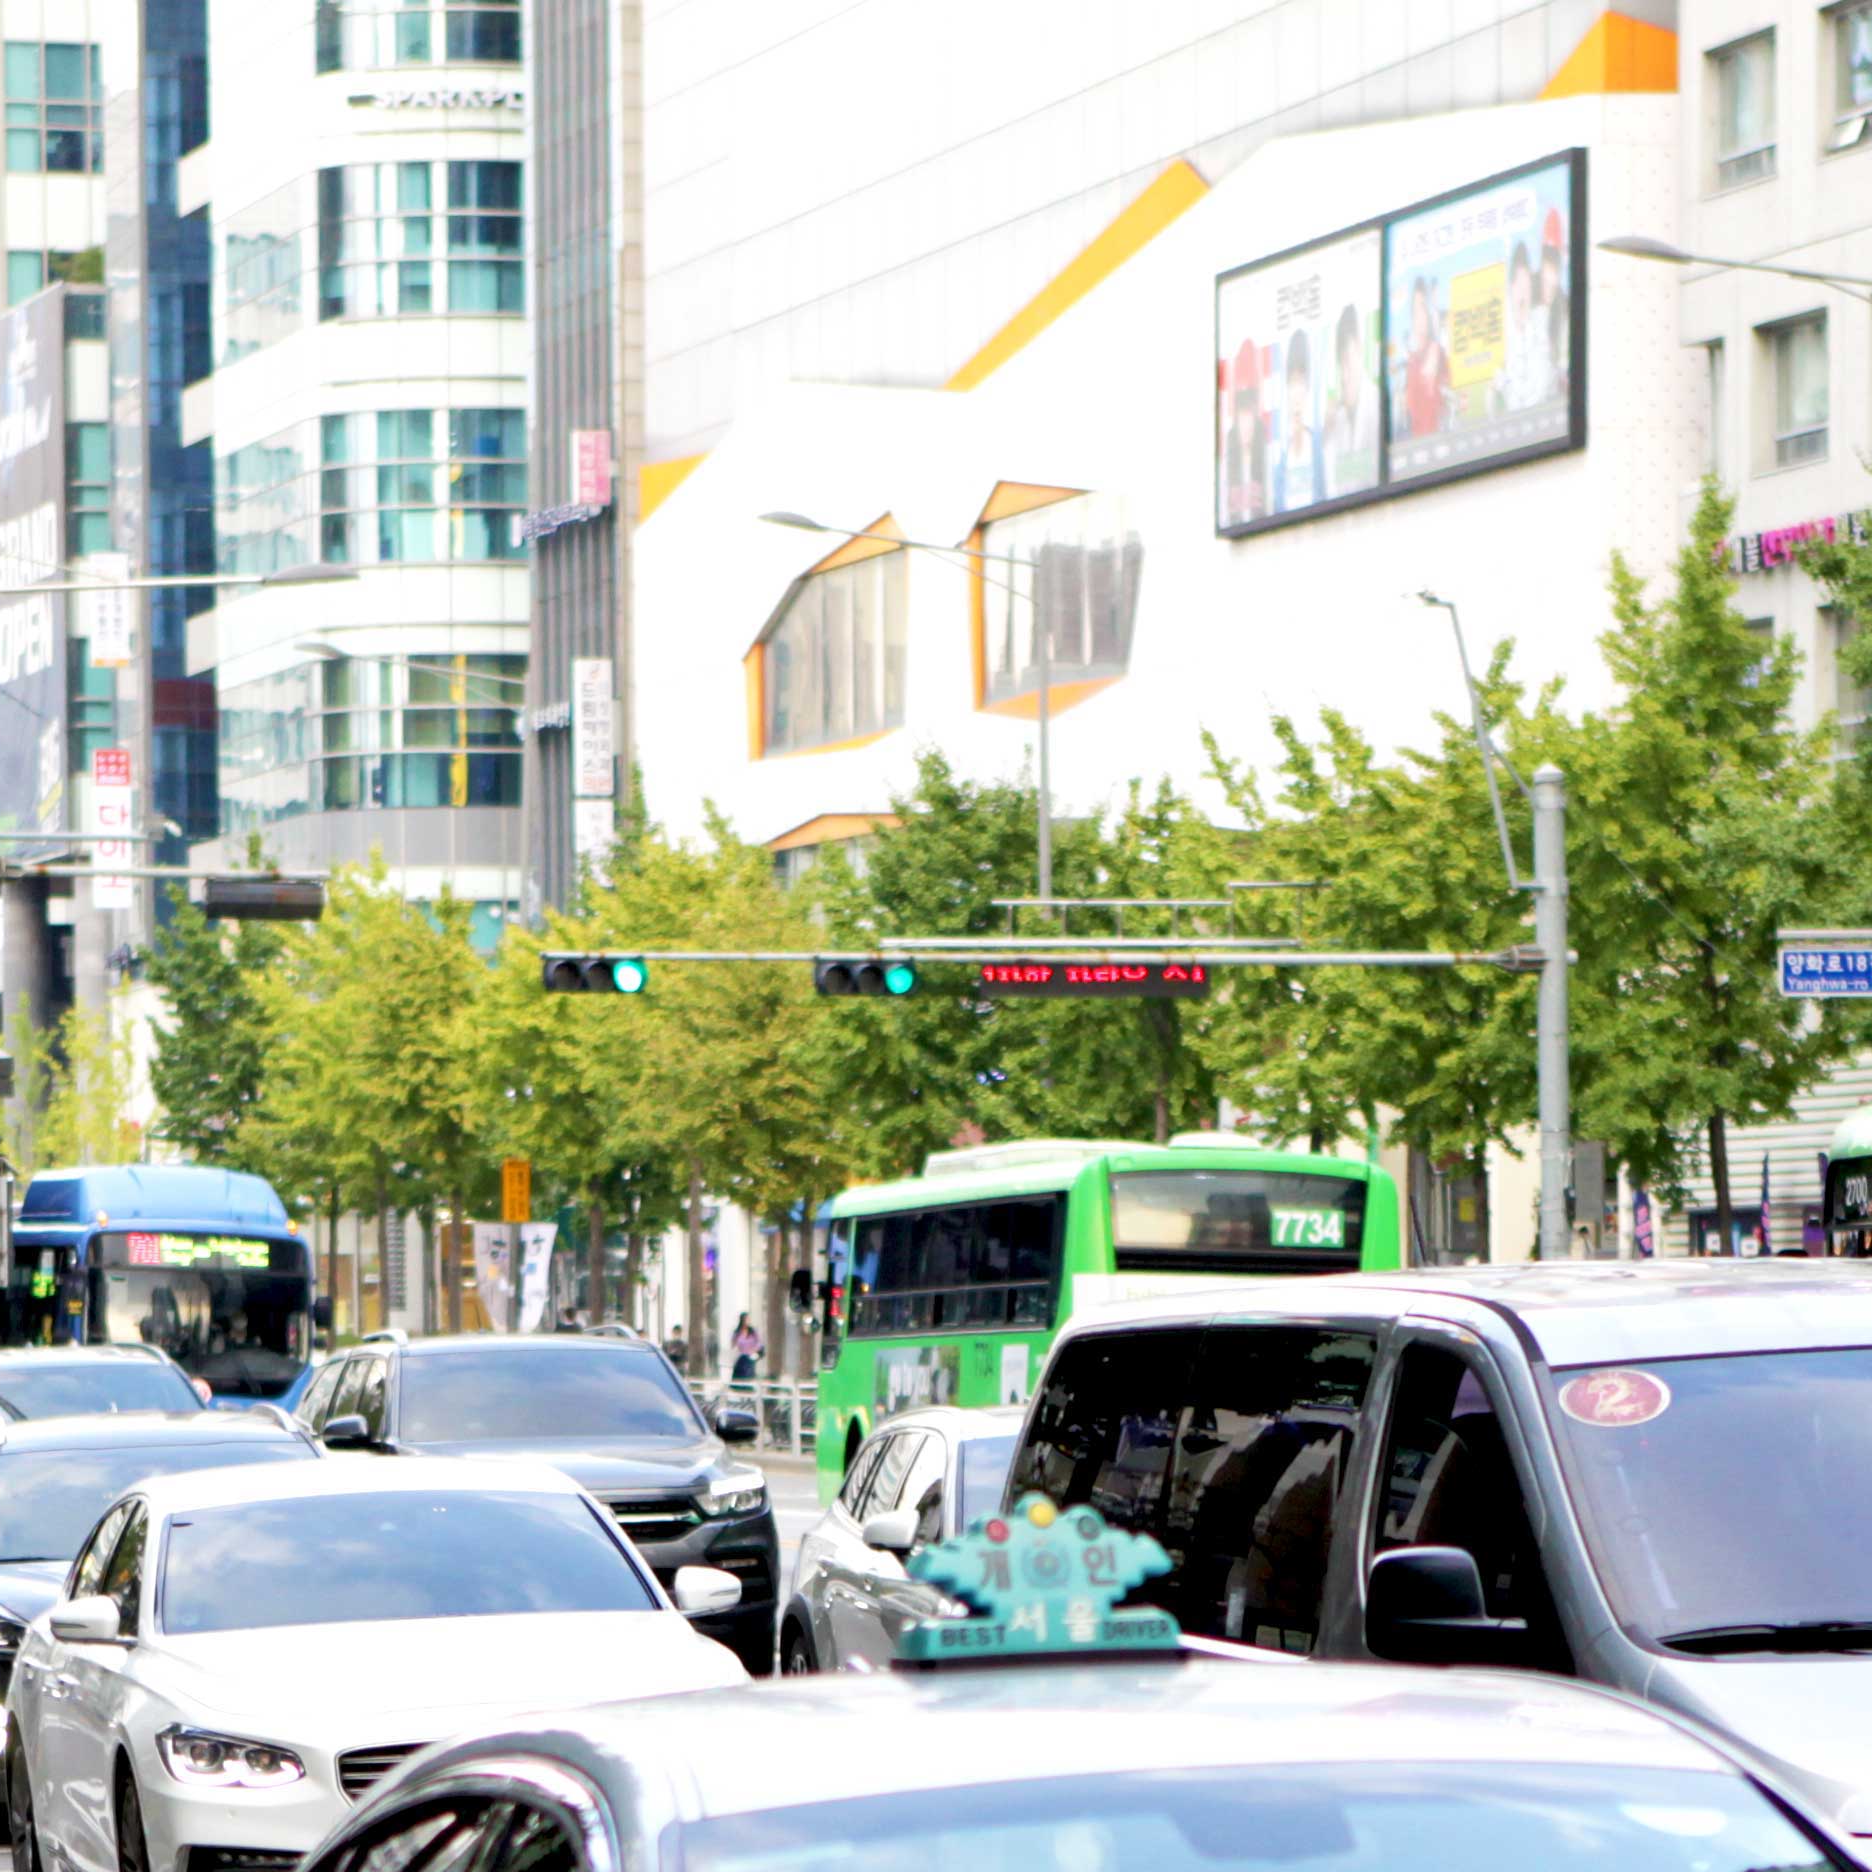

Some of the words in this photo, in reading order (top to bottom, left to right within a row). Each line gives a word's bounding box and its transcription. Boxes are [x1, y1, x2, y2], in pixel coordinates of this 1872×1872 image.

[1787, 977, 1869, 993] Yanghwa-ro
[1273, 1210, 1342, 1247] 7734
[1010, 1594, 1102, 1643] 서울
[1102, 1618, 1172, 1642] DRIVER
[939, 1625, 1006, 1648] BEST
